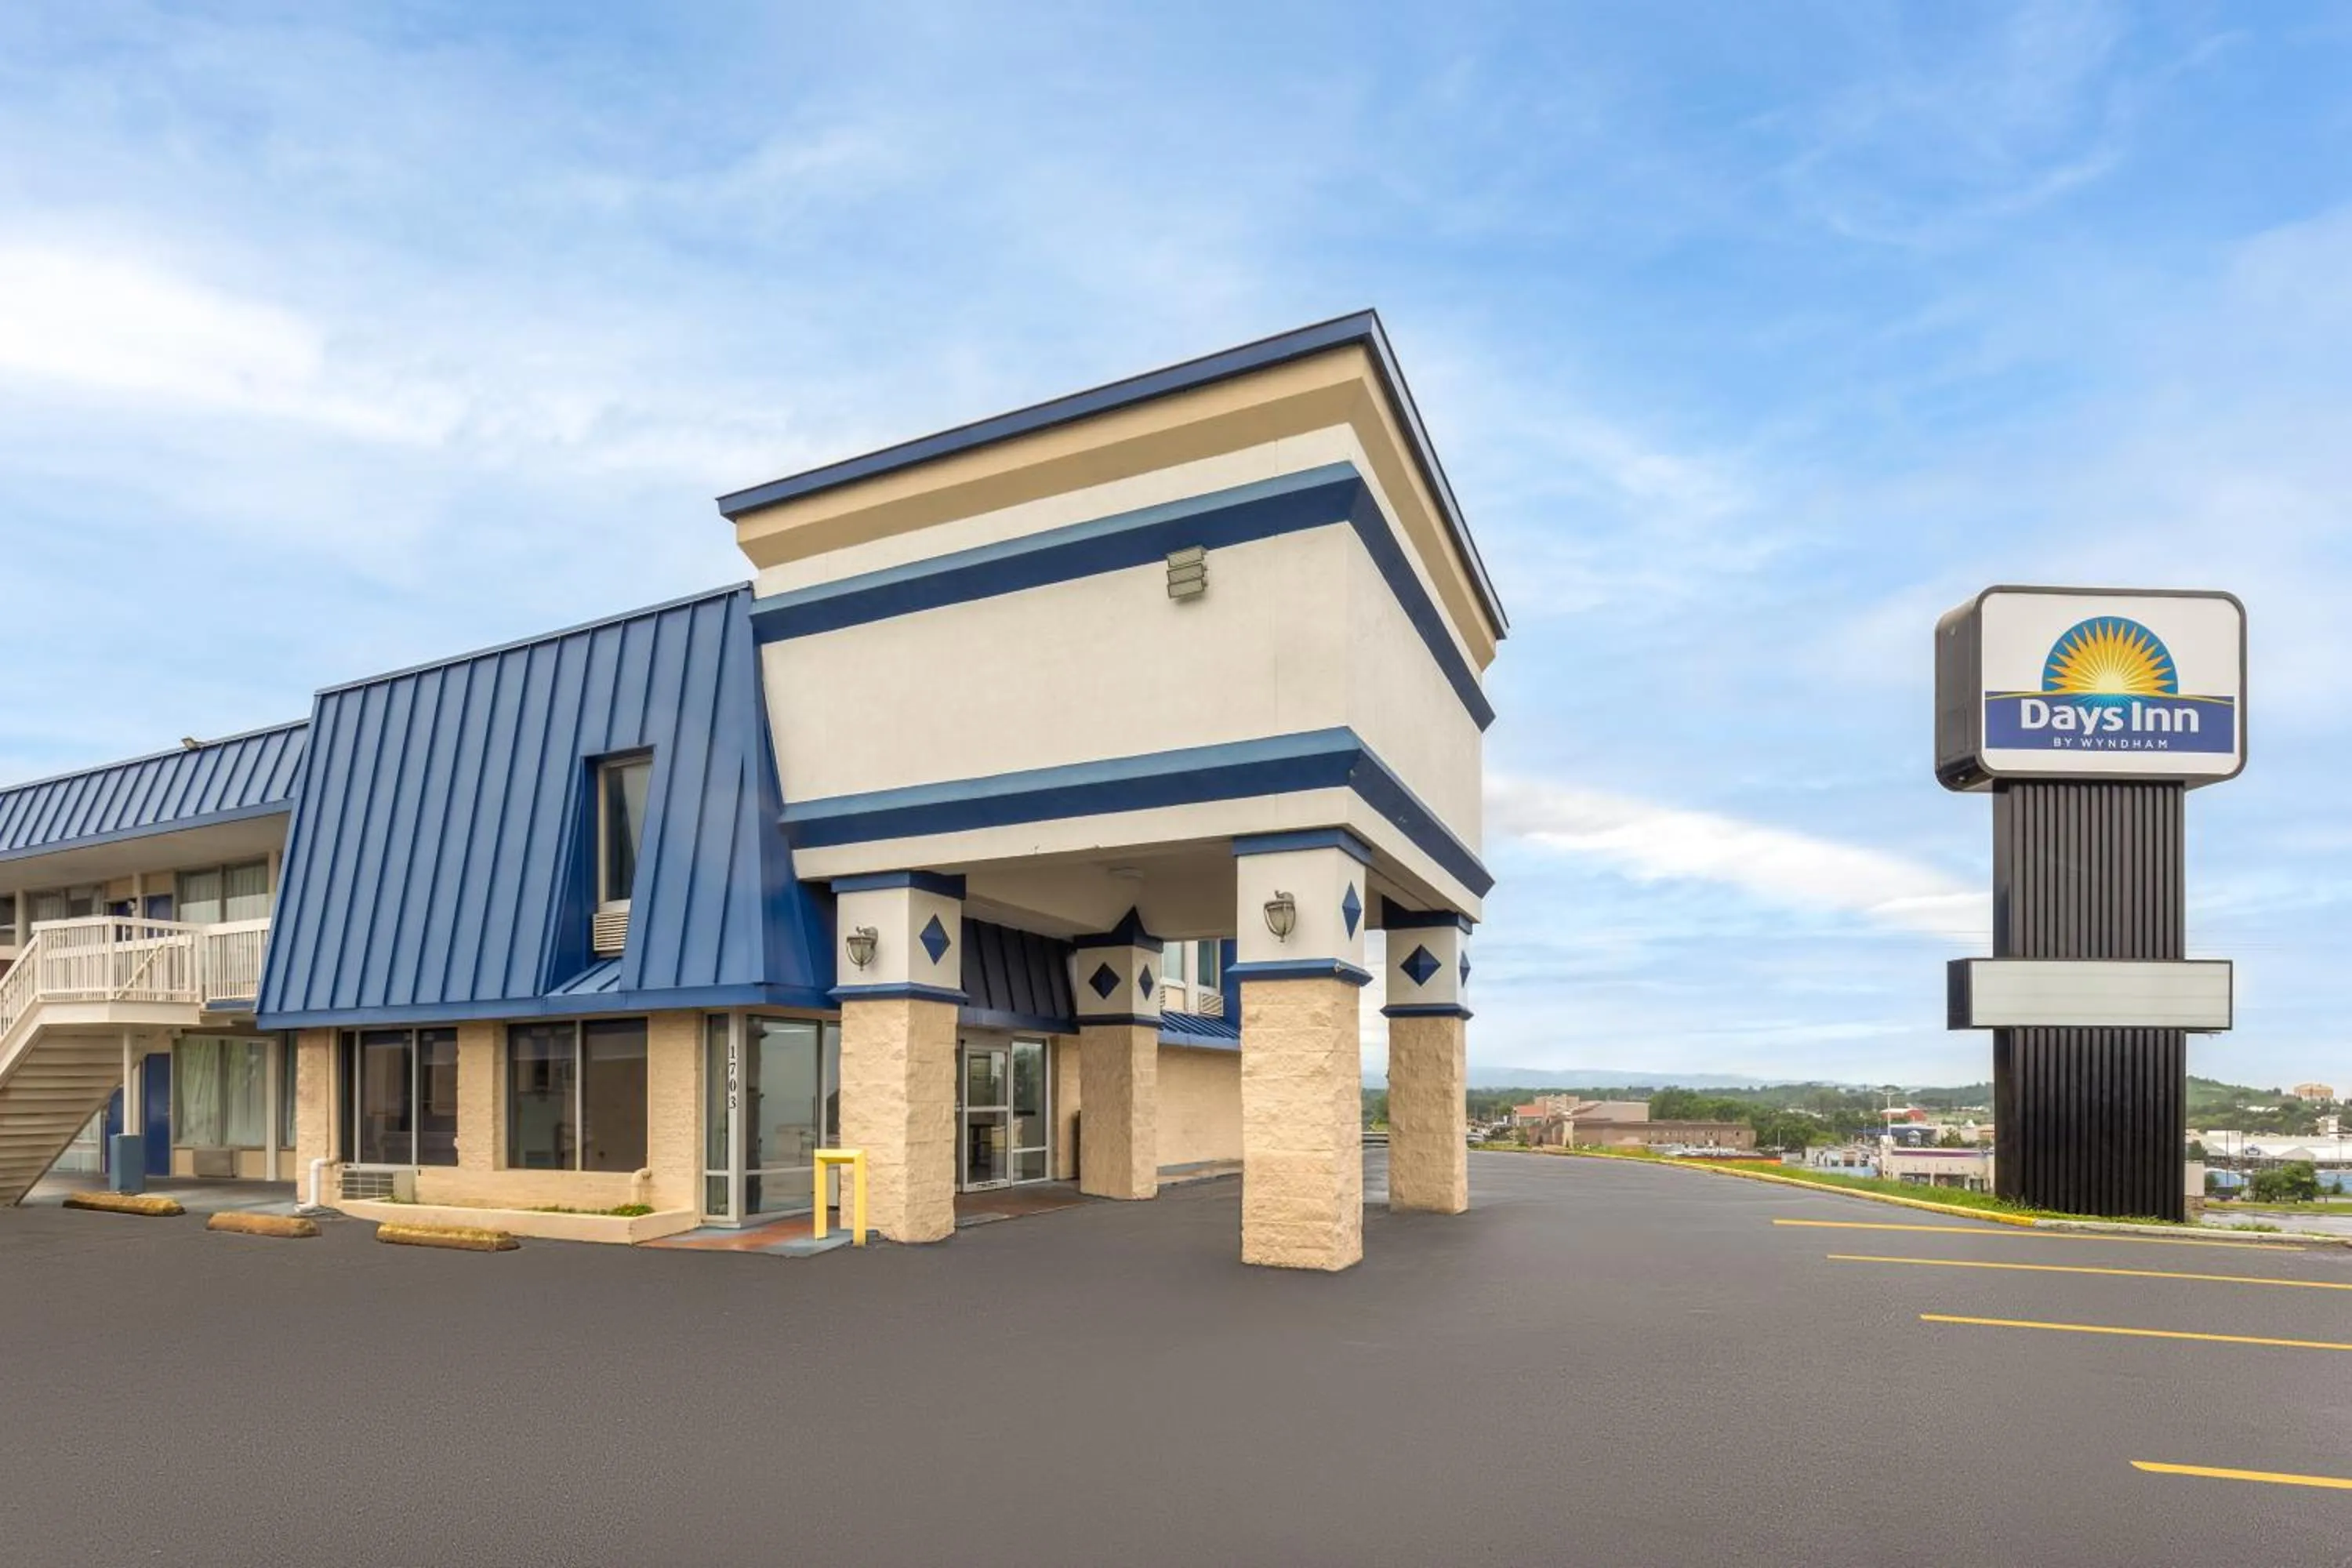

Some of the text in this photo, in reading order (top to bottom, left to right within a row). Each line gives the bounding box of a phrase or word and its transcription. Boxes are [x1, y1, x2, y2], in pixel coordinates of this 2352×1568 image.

[2020, 699, 2199, 735] Days Inn
[2053, 737, 2169, 749] BY WYNDHAM
